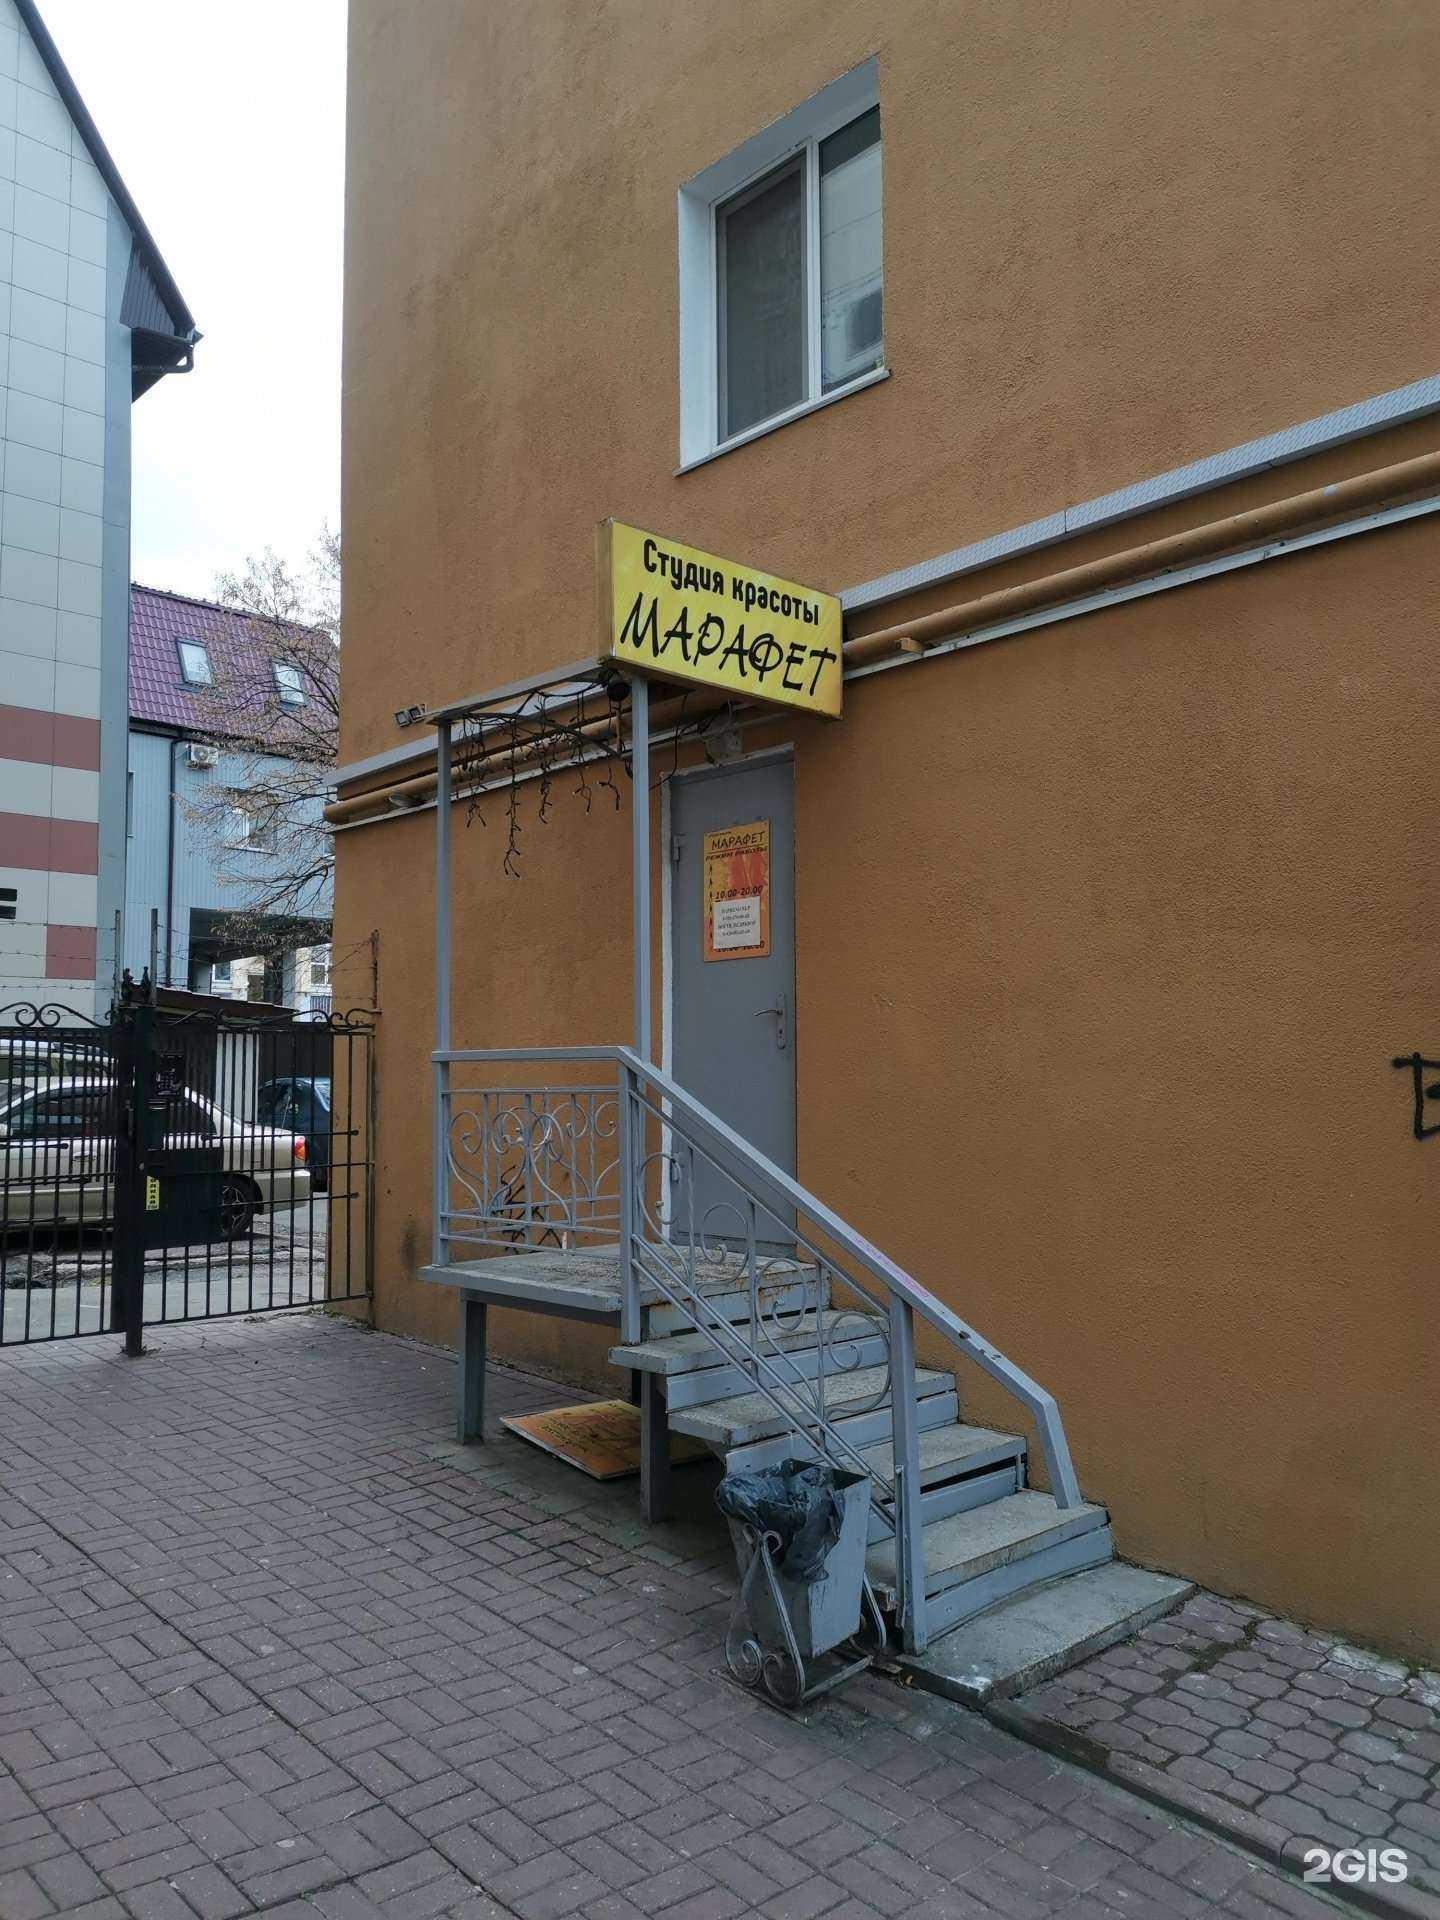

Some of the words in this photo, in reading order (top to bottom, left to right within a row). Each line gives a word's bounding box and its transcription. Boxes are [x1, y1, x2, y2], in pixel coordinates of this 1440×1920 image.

[643, 539, 724, 595] Студия
[732, 577, 819, 626] красоты
[620, 592, 836, 696] МАРАФЕТ
[711, 831, 765, 850] МАРАФЕТ
